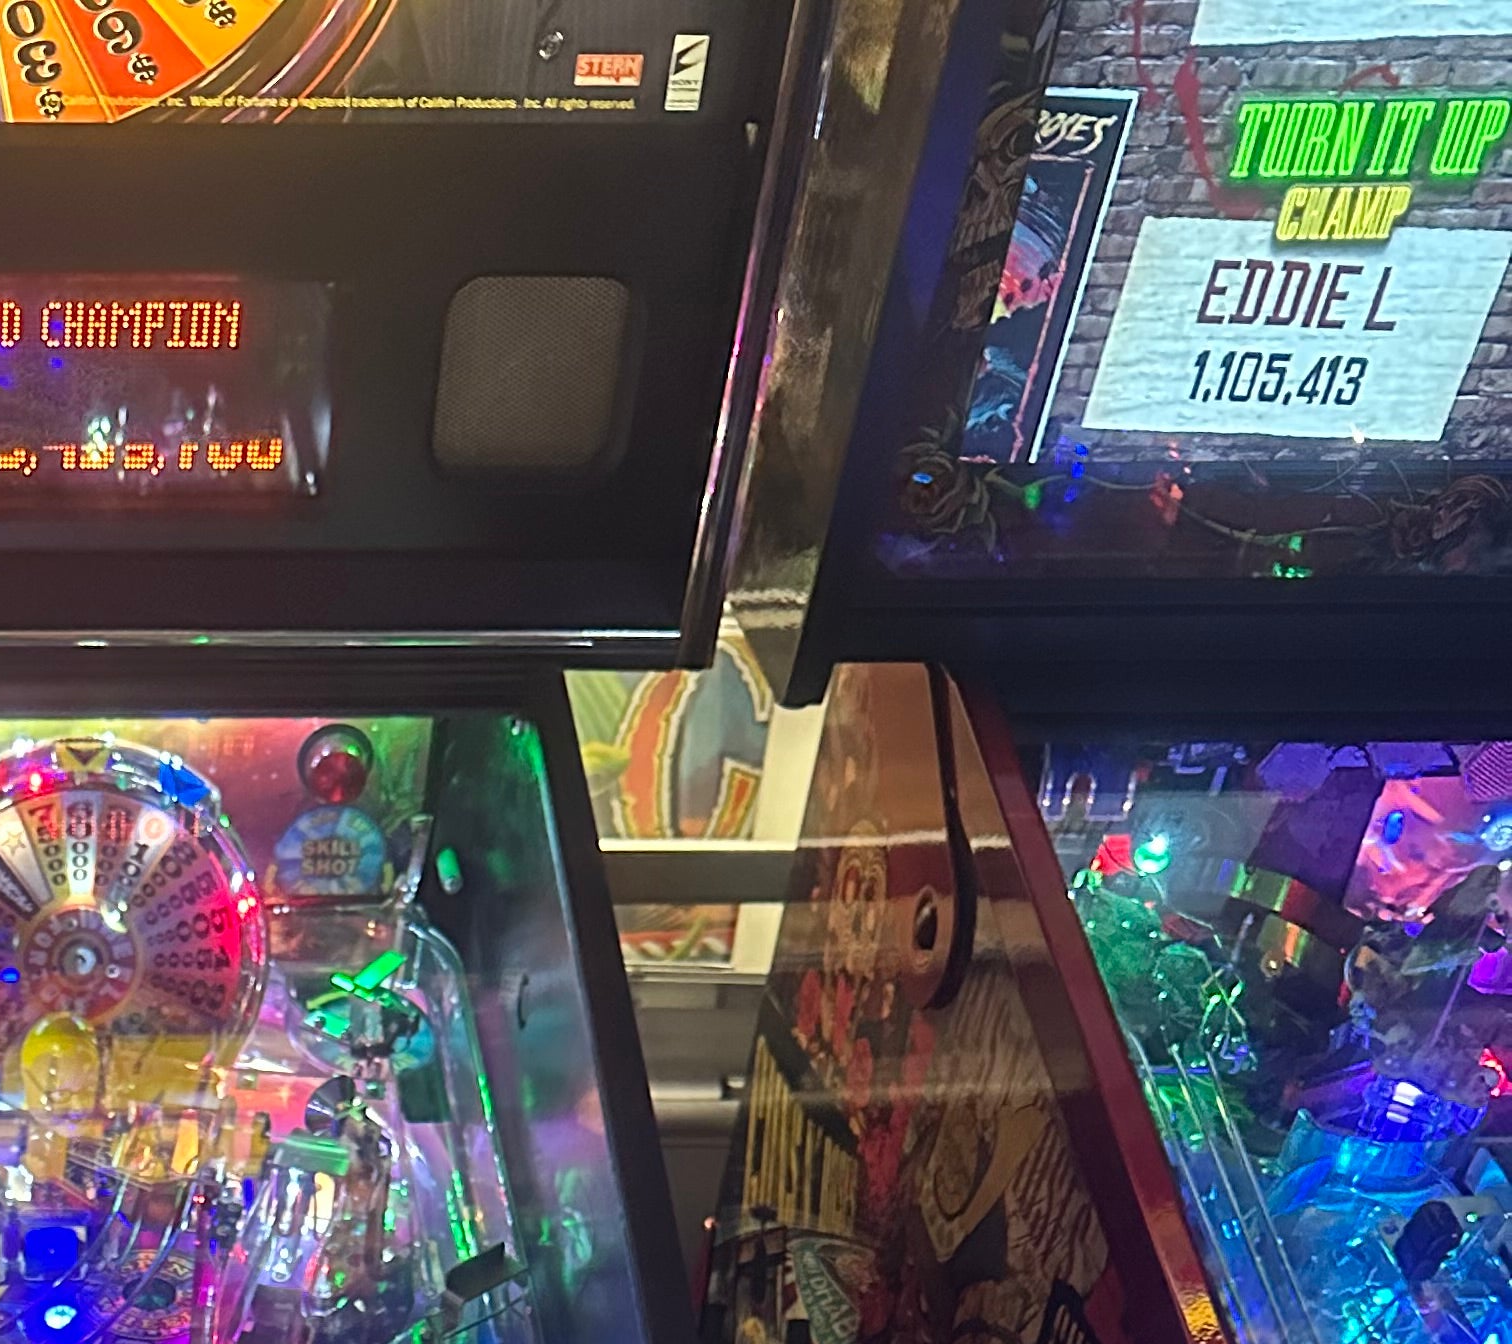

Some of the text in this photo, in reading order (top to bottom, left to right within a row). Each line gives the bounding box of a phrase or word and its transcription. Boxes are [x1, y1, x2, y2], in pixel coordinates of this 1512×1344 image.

[578, 57, 638, 83] STERN
[189, 95, 222, 107] Wheel
[237, 95, 278, 107] Fortune
[299, 97, 351, 110] registered
[352, 97, 404, 108] trademark
[560, 98, 587, 112] rights
[1230, 99, 1510, 178] TURN IT UP
[1275, 184, 1412, 241] CHAMP
[1196, 259, 1397, 333] EDDIE L
[40, 300, 242, 349] CHAMPION
[302, 839, 361, 858] SKILL
[301, 859, 357, 876] SHOT
